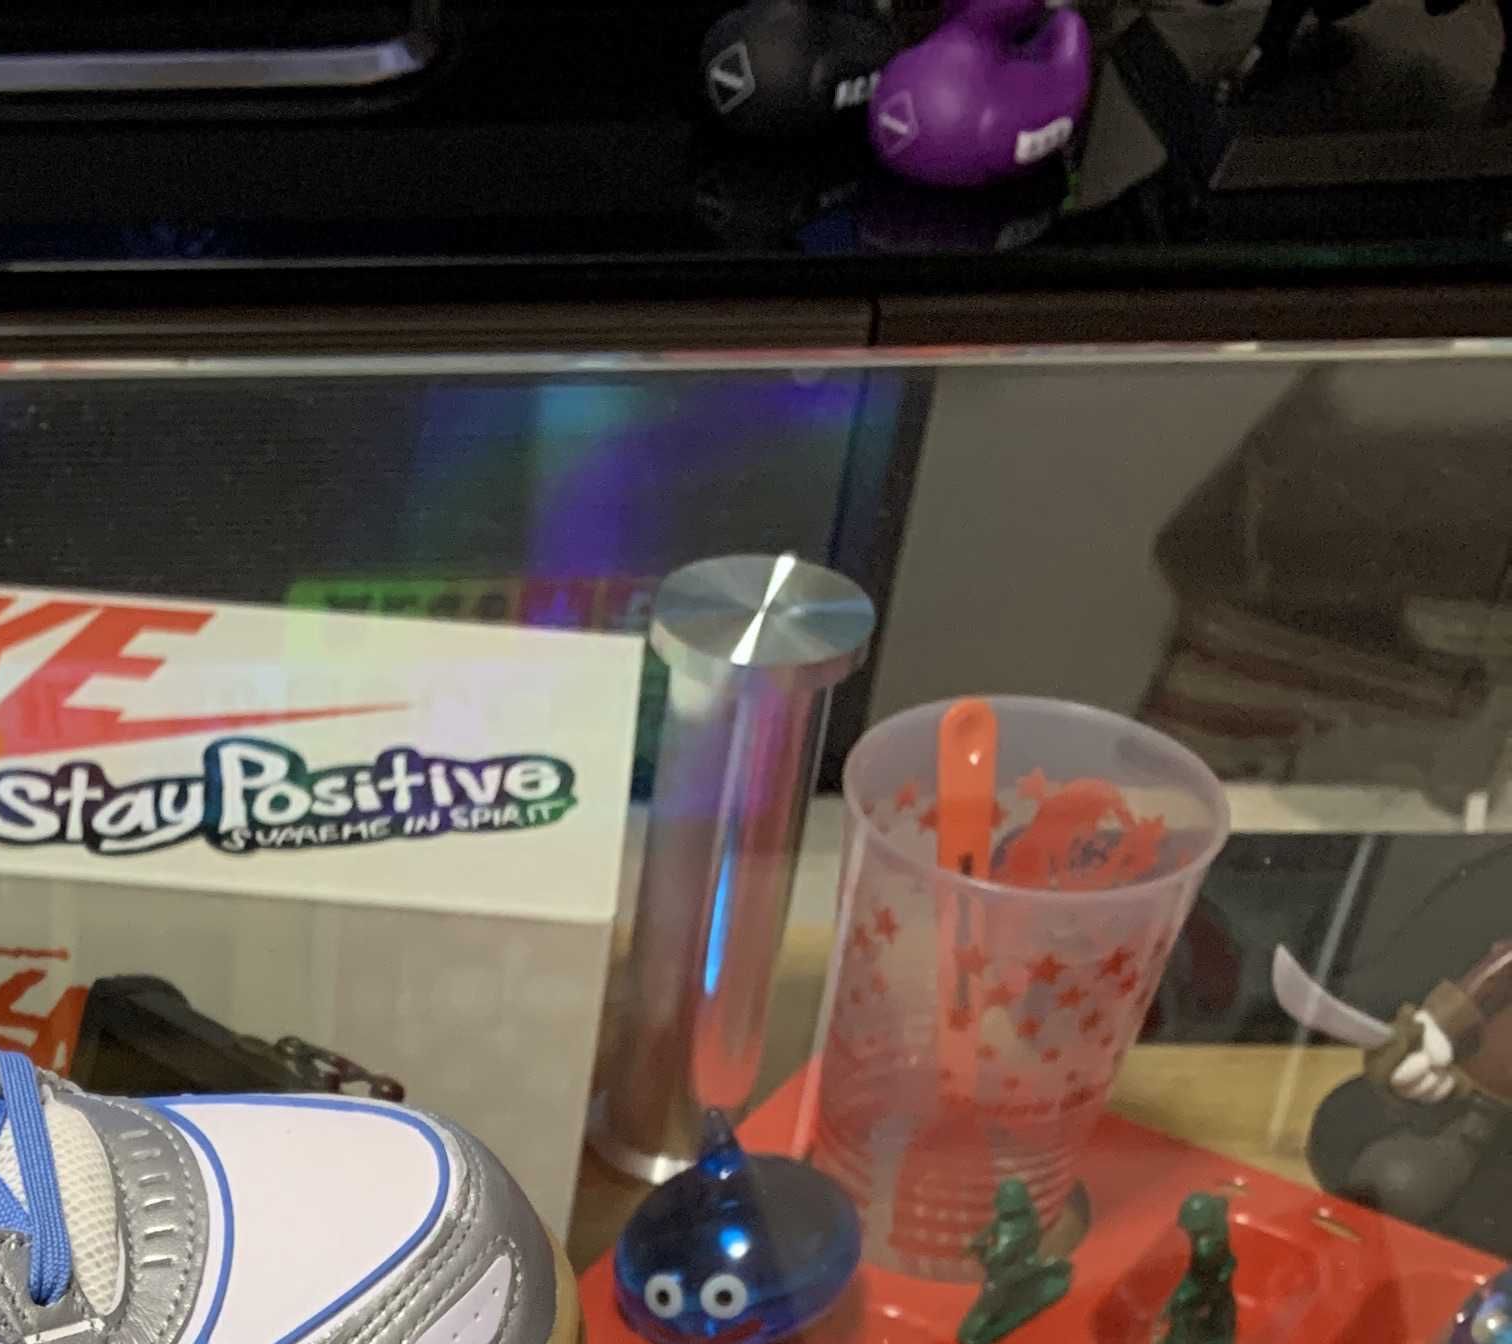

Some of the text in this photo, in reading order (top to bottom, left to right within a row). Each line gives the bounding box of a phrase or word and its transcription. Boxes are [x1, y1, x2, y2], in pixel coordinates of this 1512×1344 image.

[218, 744, 561, 833] Positive
[221, 822, 390, 853] SUPREME
[403, 813, 441, 835] IN
